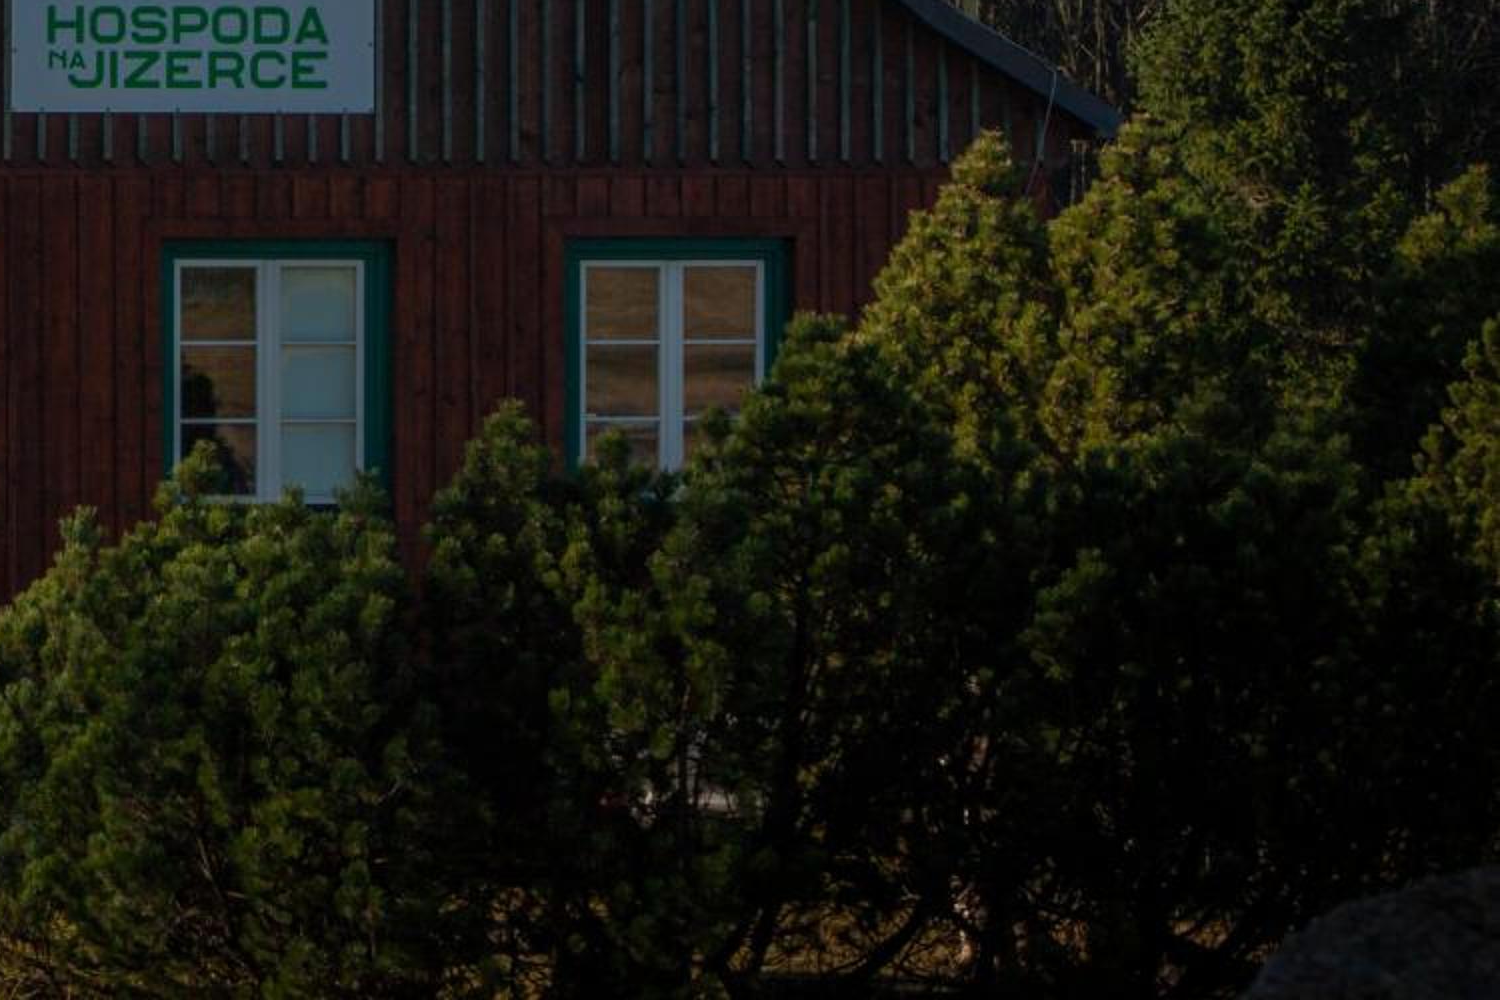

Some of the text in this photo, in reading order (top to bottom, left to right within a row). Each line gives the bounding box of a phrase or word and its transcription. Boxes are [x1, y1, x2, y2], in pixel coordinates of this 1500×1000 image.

[47, 6, 328, 45] HOSPODA
[48, 50, 328, 89] NA JIZERCE
